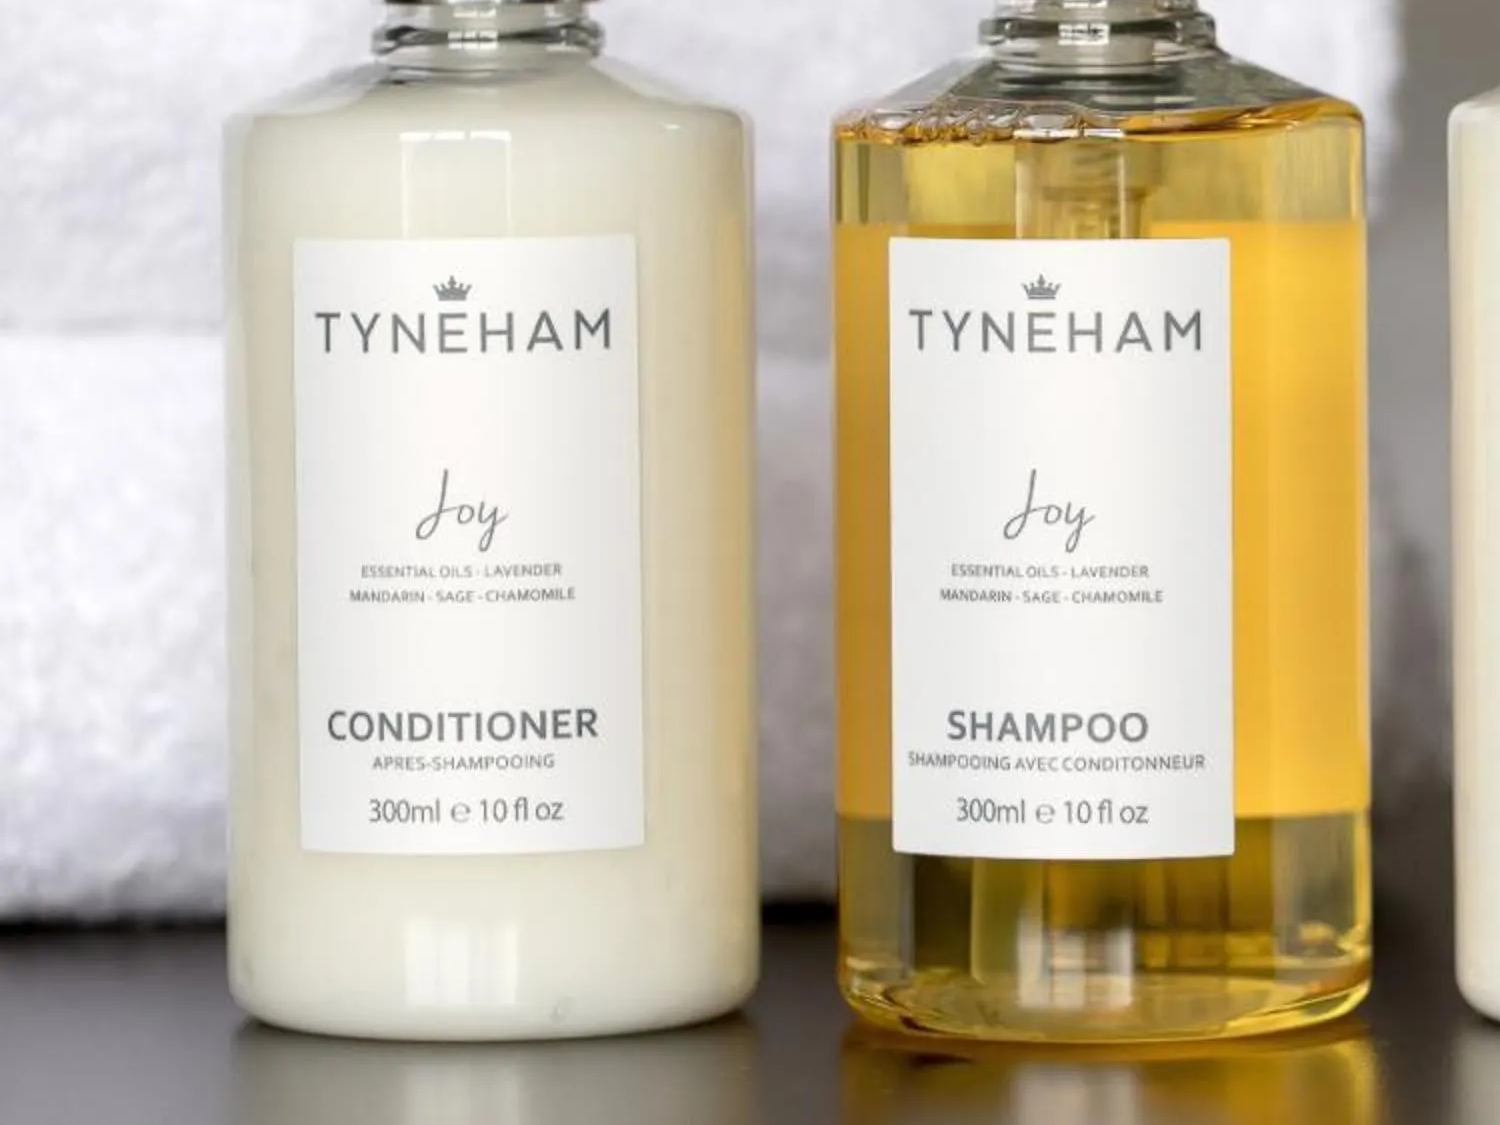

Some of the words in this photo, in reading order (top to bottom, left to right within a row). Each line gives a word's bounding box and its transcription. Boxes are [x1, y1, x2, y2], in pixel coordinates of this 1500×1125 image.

[315, 307, 612, 354] TYNEHAM
[908, 308, 1202, 354] TYNEHAM
[415, 467, 509, 553] Joy
[1003, 467, 1096, 553] Joy
[361, 564, 436, 579] ESSENTIAL
[439, 564, 472, 579] OILS
[484, 562, 563, 578] LAVENDER
[950, 563, 1023, 578] ESSENTIAL
[1026, 565, 1059, 579] OILS
[1071, 565, 1150, 579] LAVENDER
[349, 590, 424, 603] MANDARIN
[436, 590, 474, 603] SAGE
[486, 586, 576, 602] CHAMOMILE
[940, 588, 1012, 603] MANDARIN
[1022, 590, 1061, 604] SAGE
[1072, 590, 1163, 604] CHAMOMILE
[327, 707, 600, 743] CONDITIONER
[946, 709, 1149, 744] SHAMPOO
[908, 751, 1011, 771] SHAMPOOING
[1014, 756, 1059, 772] AVEC
[1062, 754, 1206, 772] CONDITONNEUR
[368, 797, 441, 824] 300ml
[479, 798, 508, 823] 10
[514, 795, 529, 822] fl
[534, 801, 565, 822] oz
[956, 796, 1026, 824] 300ml
[1064, 799, 1091, 825] 10
[1098, 798, 1113, 825] fl
[1119, 803, 1149, 825] oz
